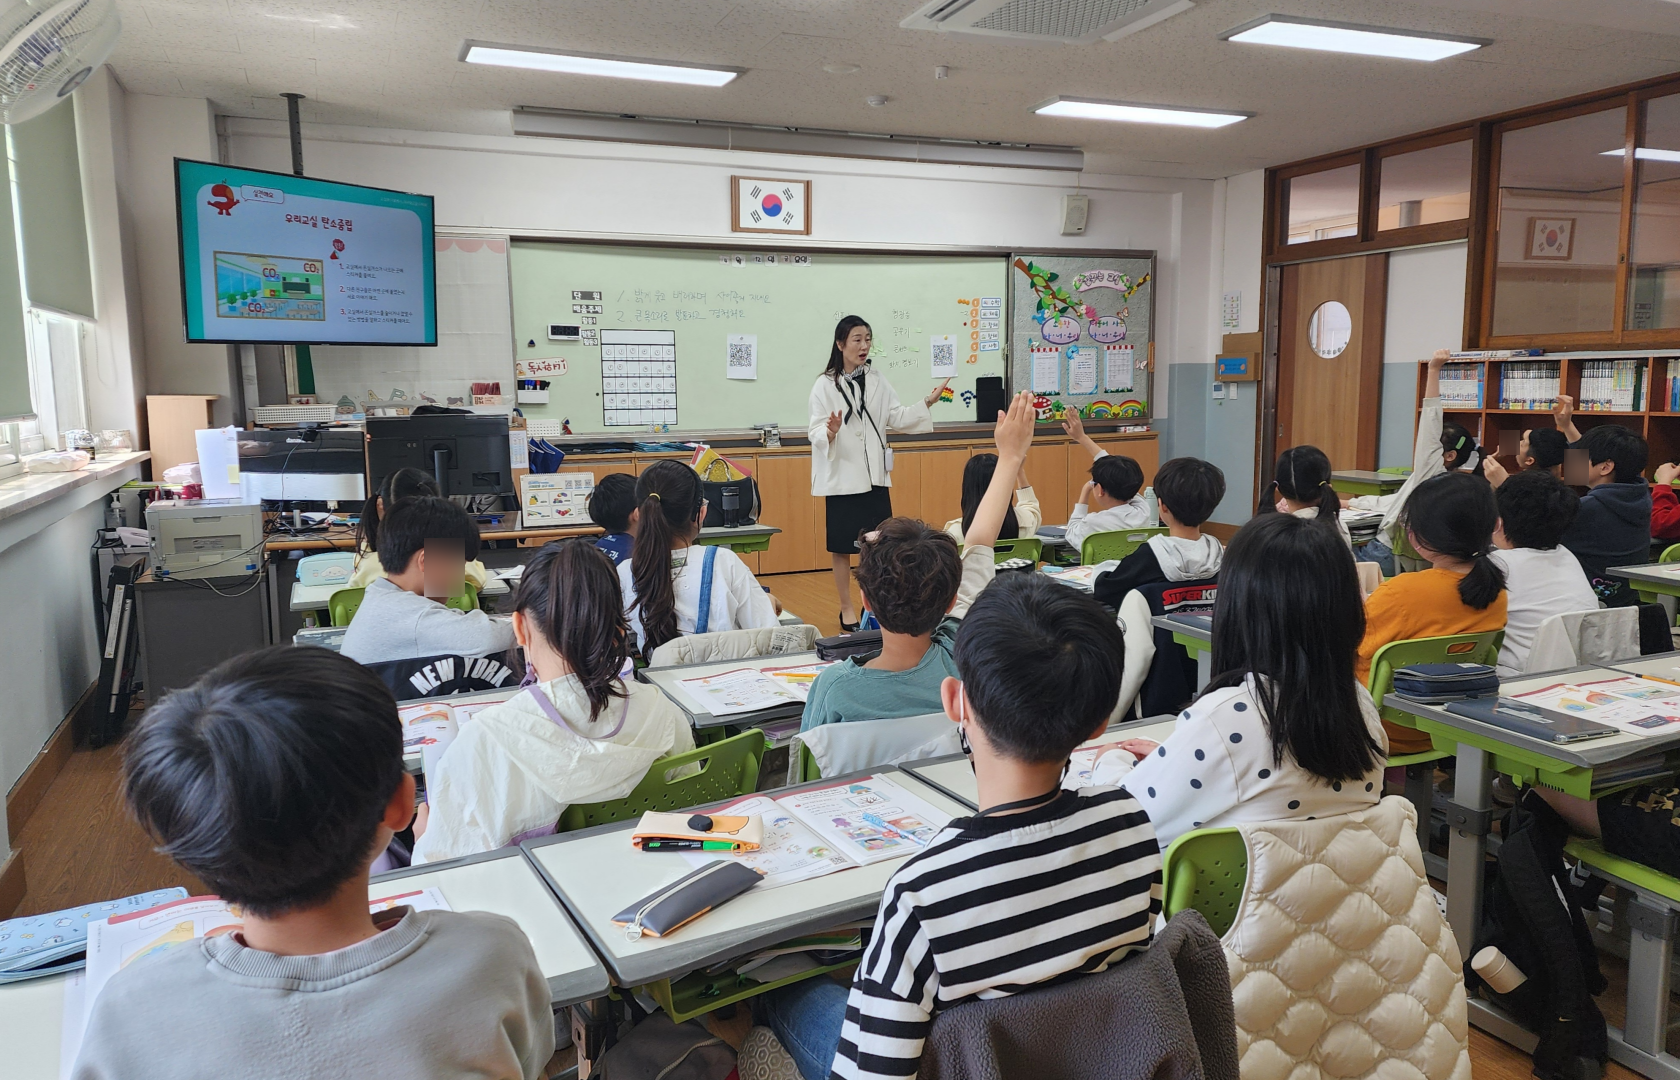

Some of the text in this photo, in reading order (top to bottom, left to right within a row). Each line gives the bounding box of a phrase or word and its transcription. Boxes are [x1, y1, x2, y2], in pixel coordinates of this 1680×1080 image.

[285, 213, 353, 232] 우리교실 탄소중립
[573, 304, 602, 314] 배움주제
[408, 657, 513, 695] NEW YORK
